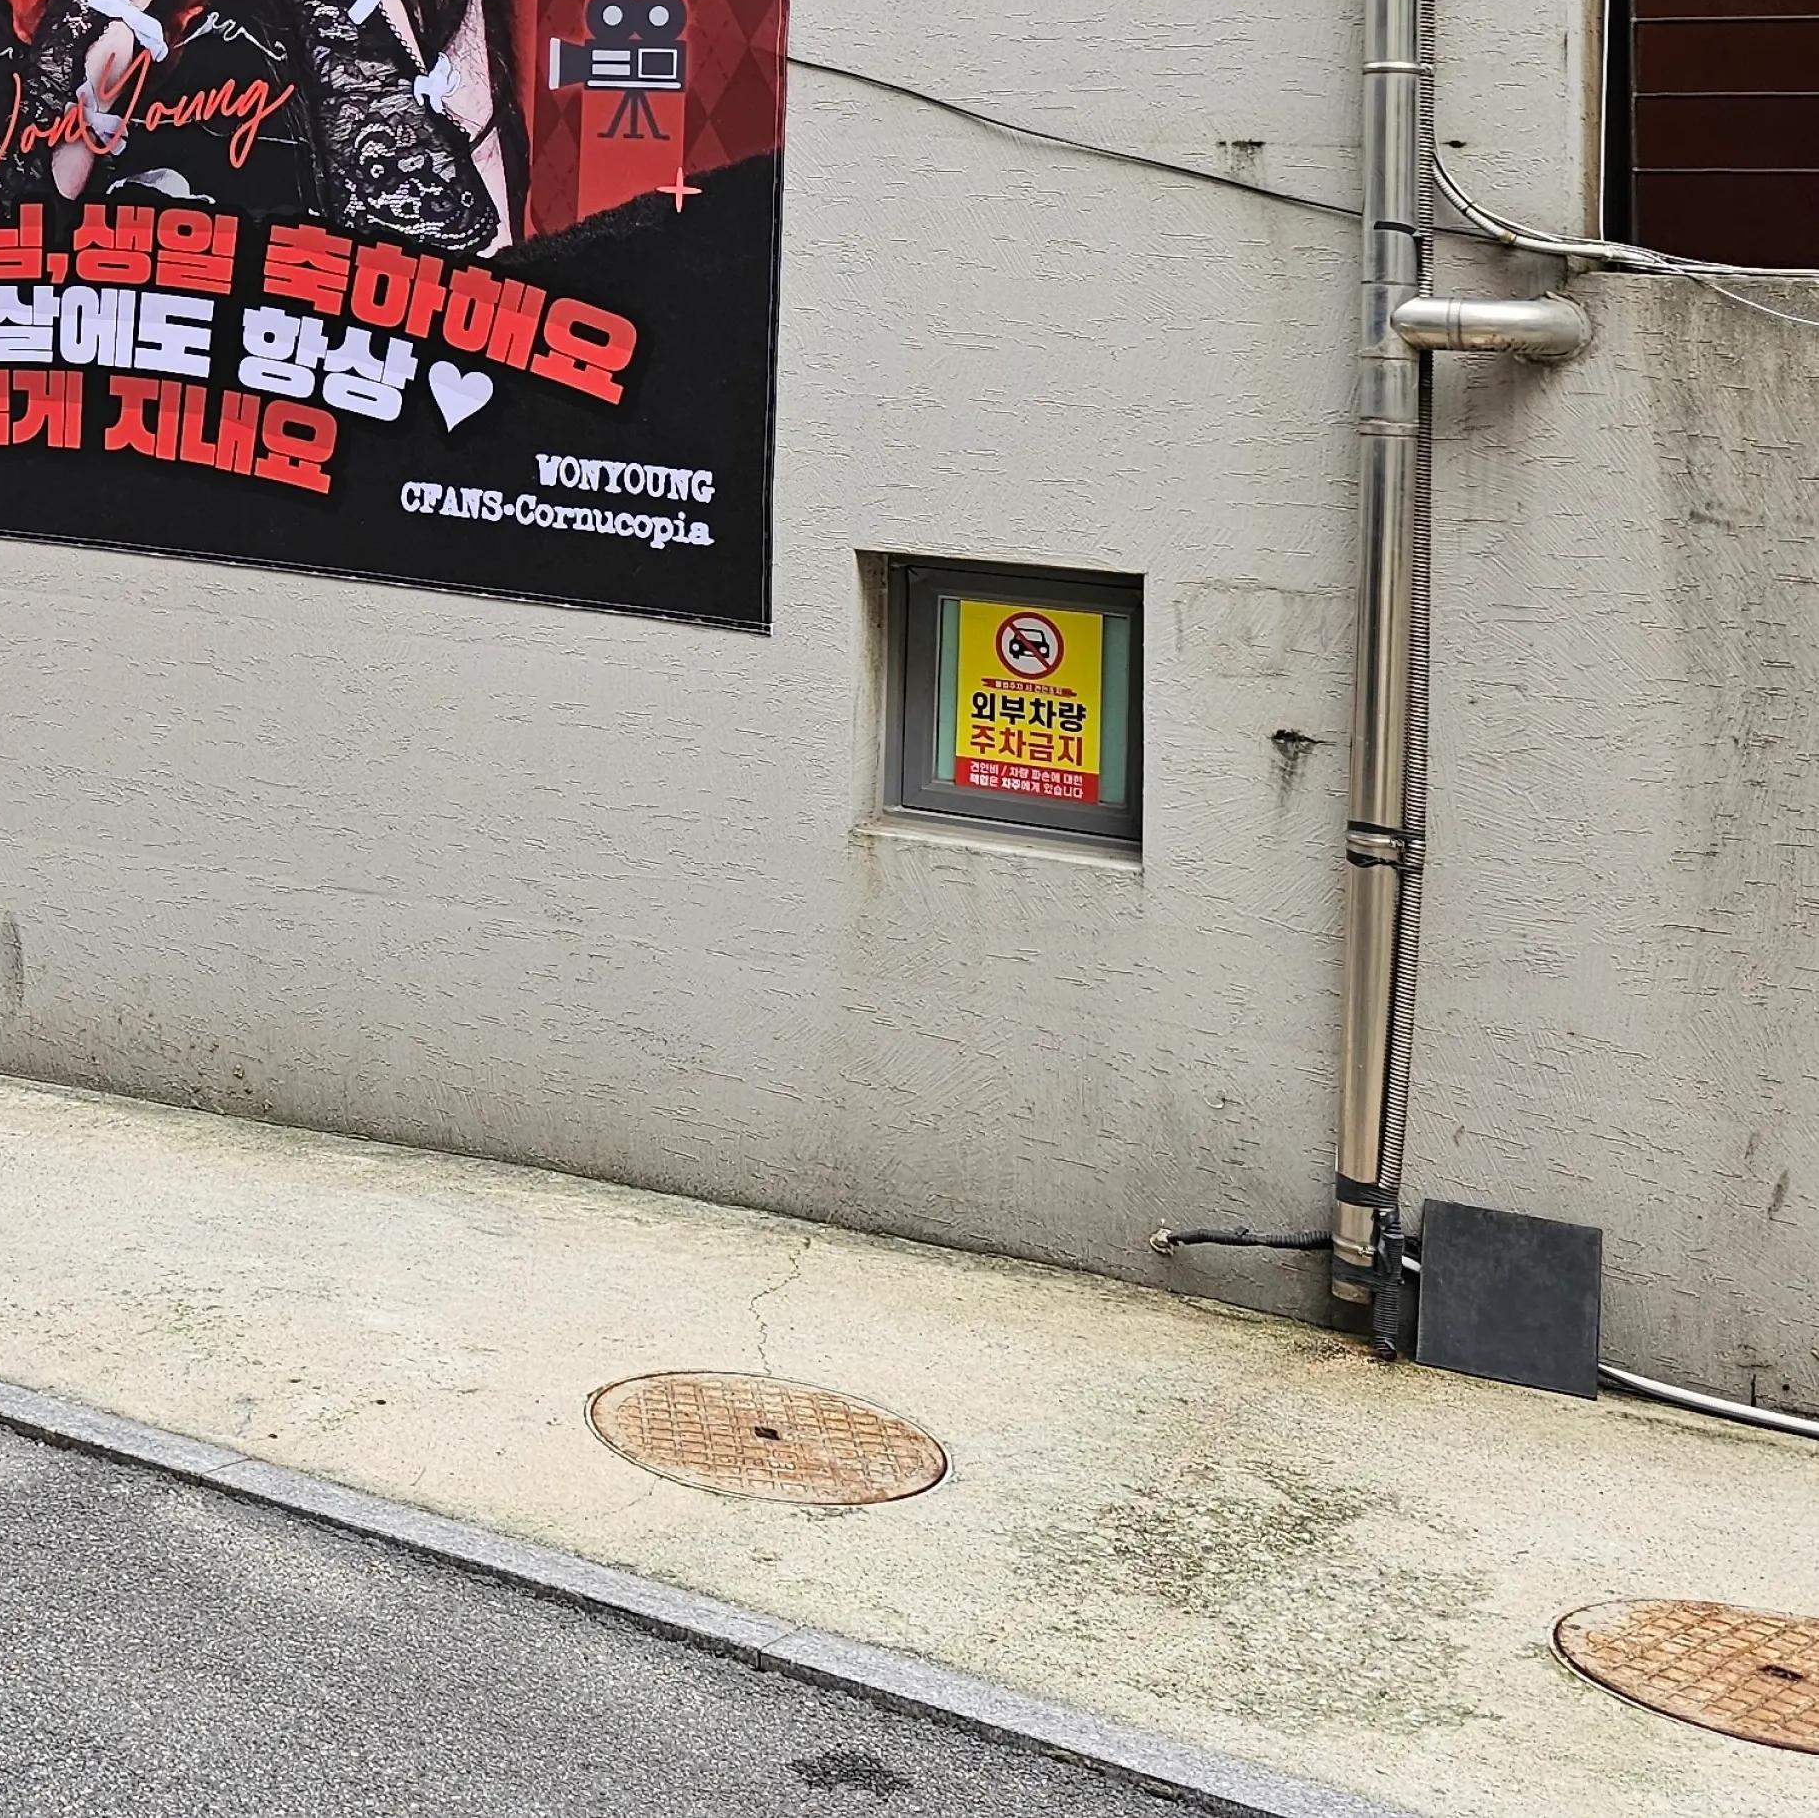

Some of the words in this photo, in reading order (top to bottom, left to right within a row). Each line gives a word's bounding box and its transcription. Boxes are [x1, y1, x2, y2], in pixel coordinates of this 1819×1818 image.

[262, 223, 638, 406] 축하해요
[237, 304, 419, 422] 항상
[105, 374, 338, 495] 지내요
[535, 452, 716, 503] WONYOUNG
[970, 724, 1083, 767] 주차금지
[971, 691, 1087, 733] 외부차량
